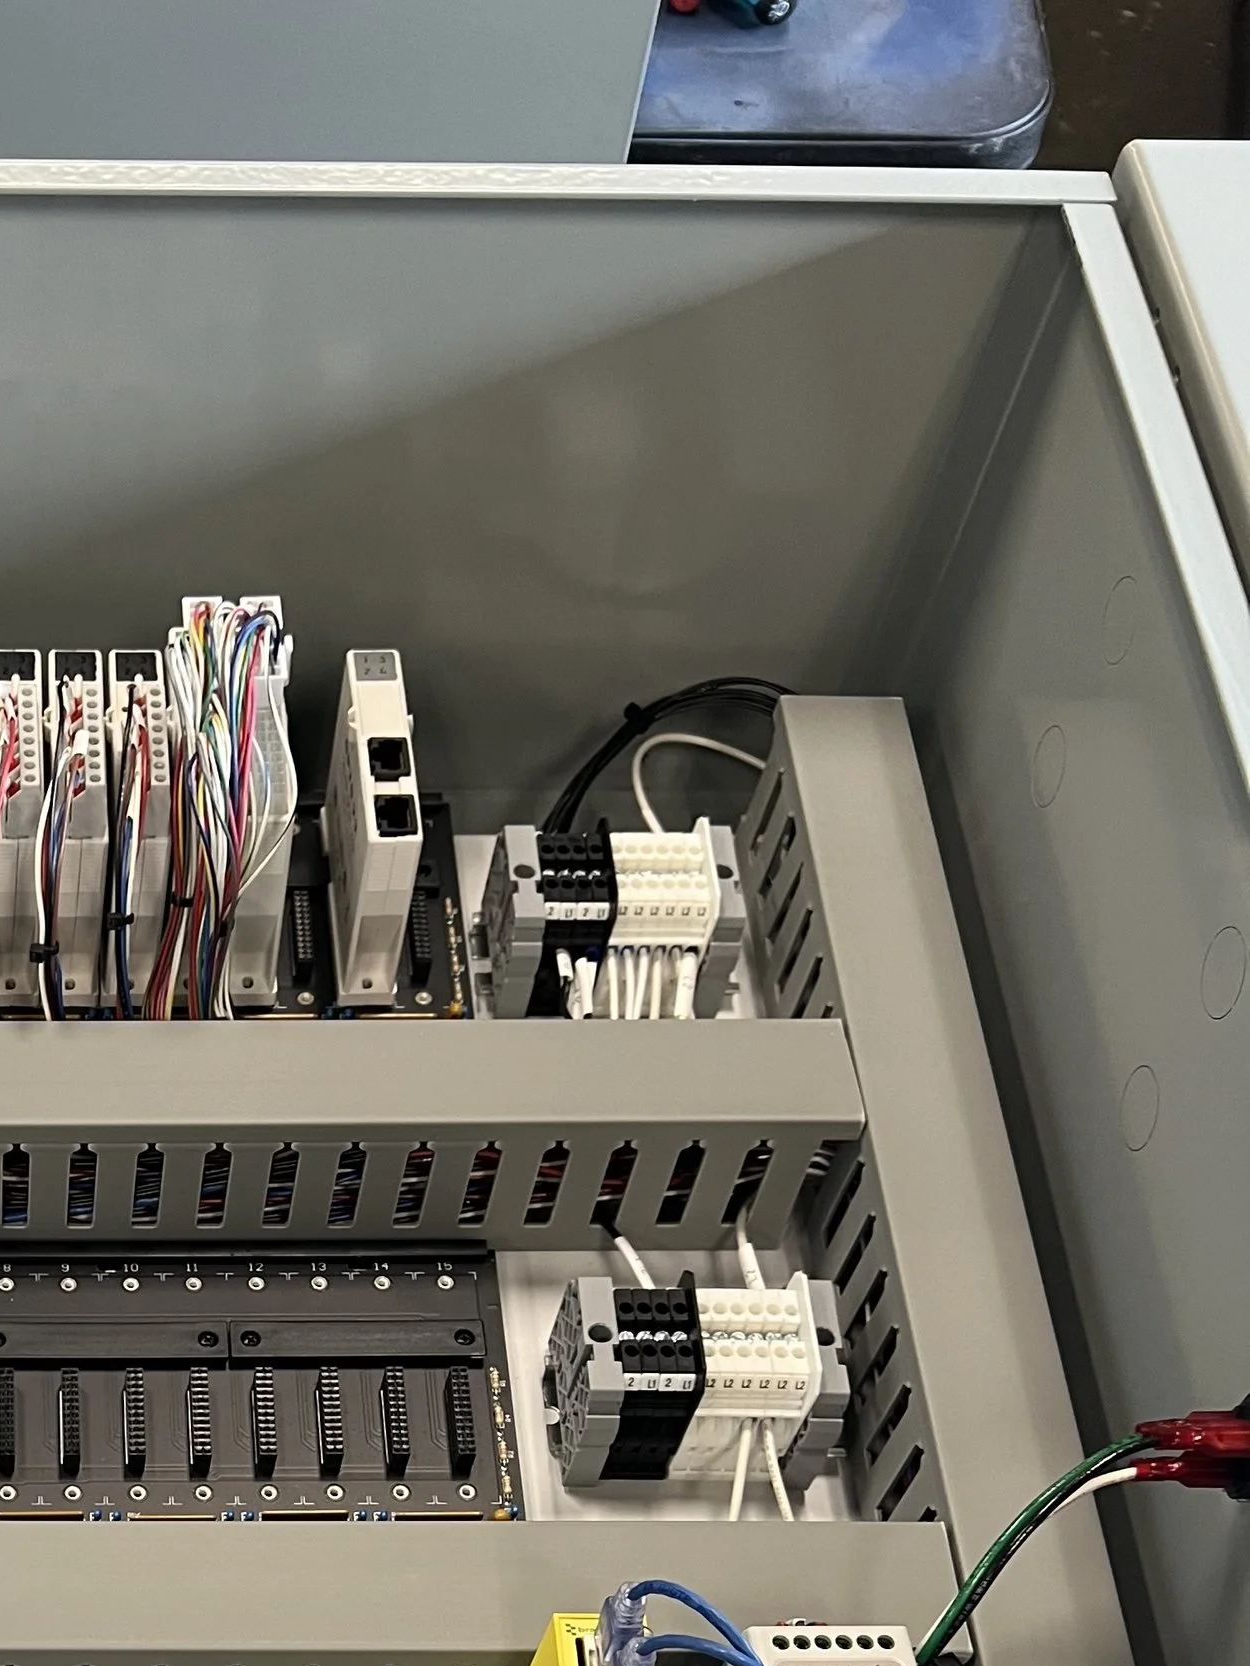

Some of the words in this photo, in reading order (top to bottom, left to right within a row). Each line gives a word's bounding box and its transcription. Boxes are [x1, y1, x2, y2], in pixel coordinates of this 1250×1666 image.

[3, 1264, 12, 1272] 8
[61, 1264, 70, 1272] 9
[124, 1264, 139, 1272] 10
[186, 1264, 198, 1272] 11
[249, 1264, 264, 1272] 12
[311, 1263, 327, 1271] 13
[374, 1263, 389, 1271] 14
[437, 1263, 453, 1271] 15
[627, 1377, 635, 1388] 2
[647, 1379, 657, 1389] L1
[664, 1377, 672, 1388] 2
[682, 1379, 693, 1390] L1
[723, 1378, 734, 1389] L2
[741, 1379, 752, 1389] L2
[759, 1379, 770, 1390] L2
[777, 1380, 787, 1390] L2
[795, 1381, 805, 1391] L2
